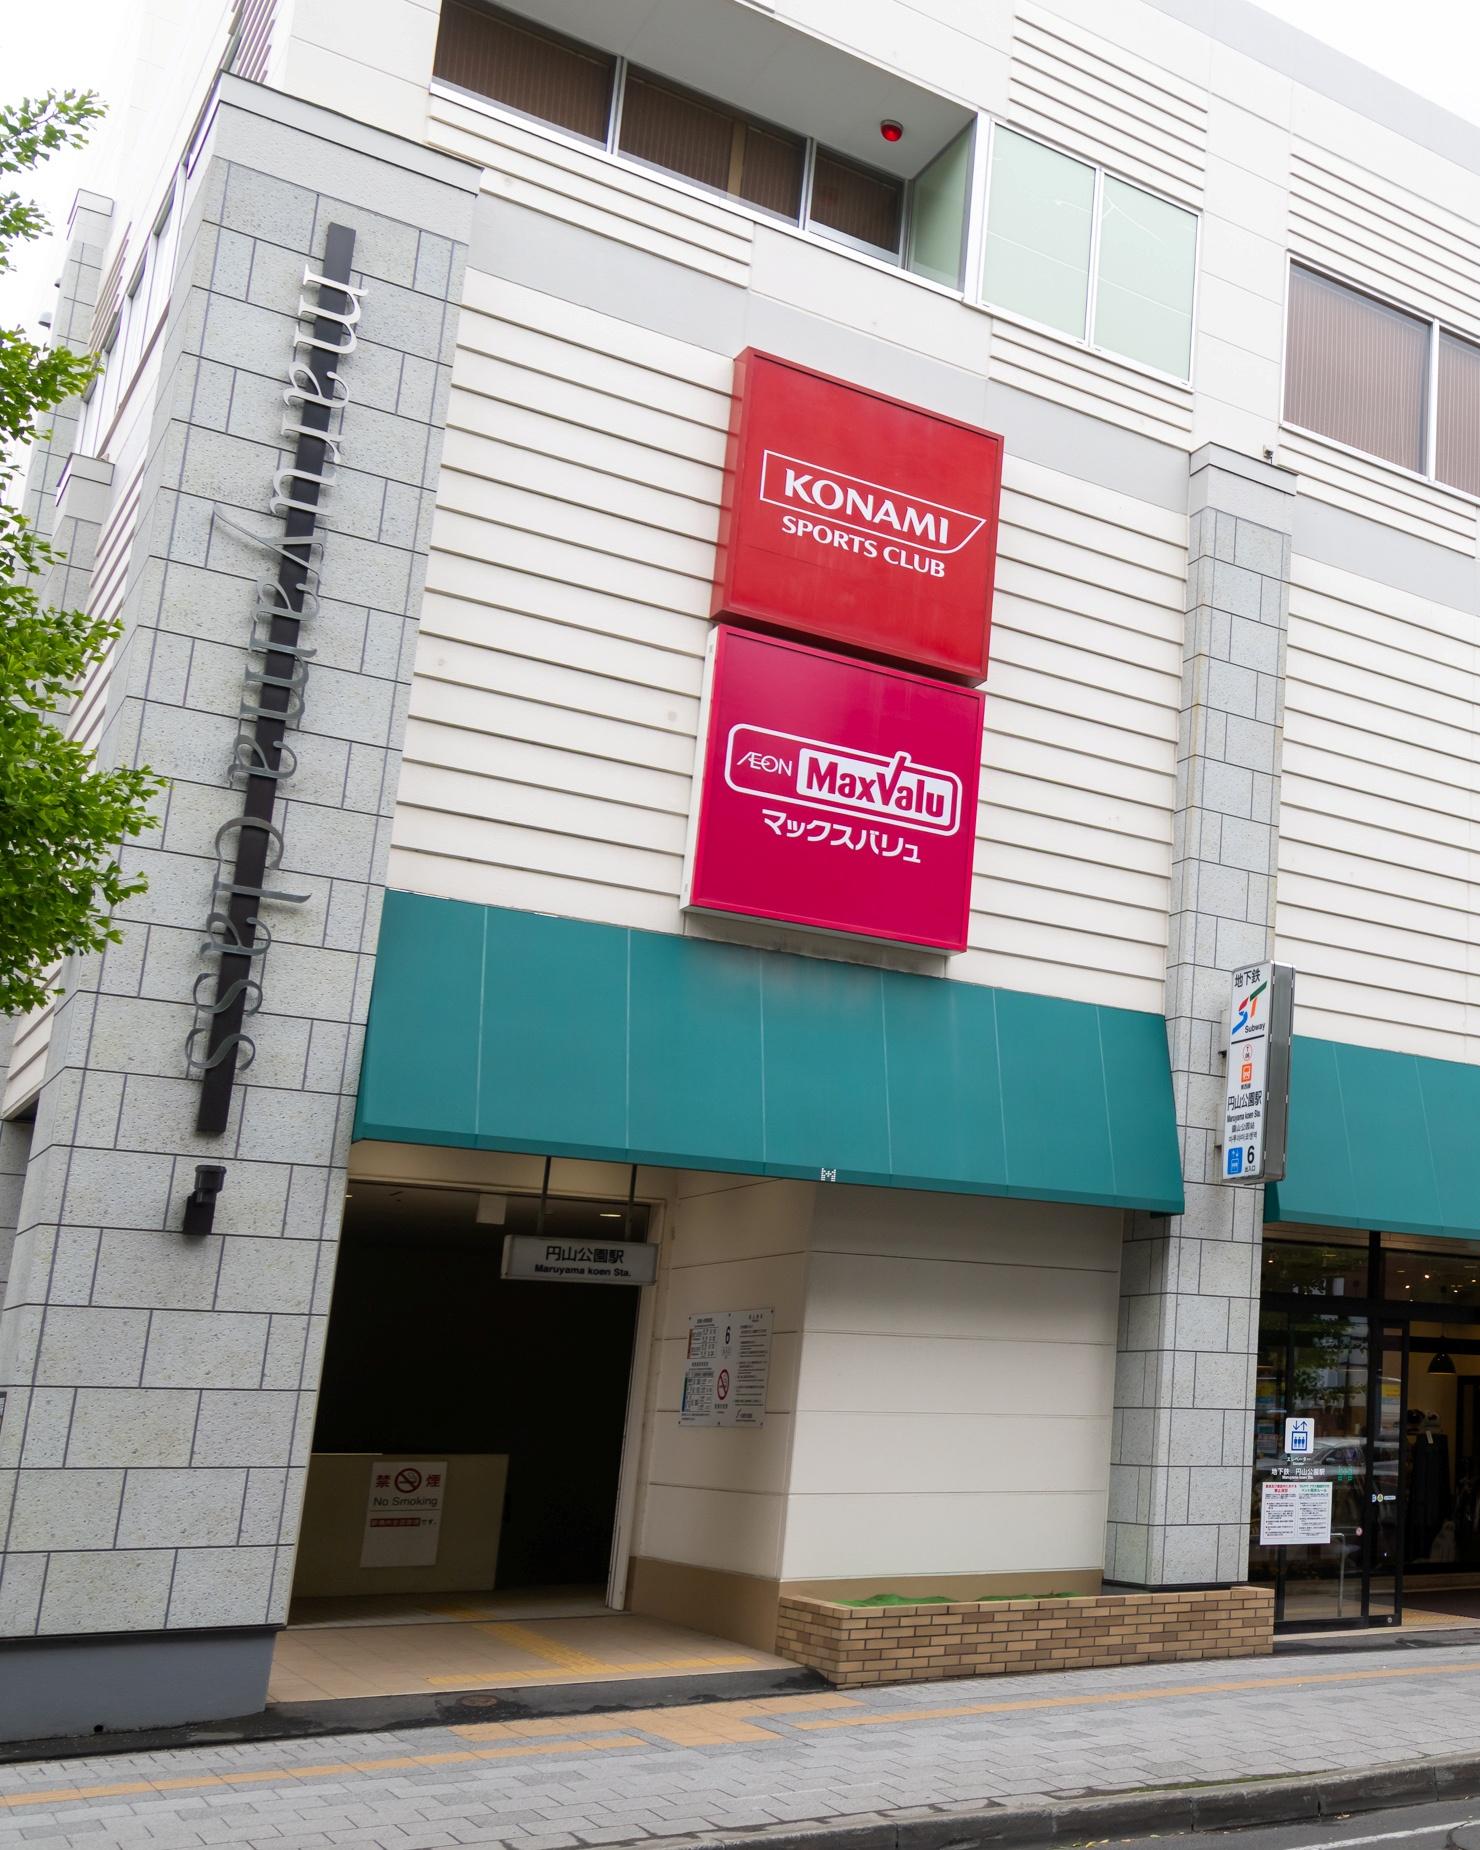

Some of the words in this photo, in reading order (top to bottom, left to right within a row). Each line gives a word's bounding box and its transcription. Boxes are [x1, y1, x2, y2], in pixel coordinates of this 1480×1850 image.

[784, 468, 949, 544] KONAMI
[781, 515, 878, 558] SPORTS
[882, 546, 945, 578] CLUB
[806, 755, 945, 818] MaxValu
[761, 808, 921, 863] マックスバリュ
[1234, 967, 1261, 988] 地下鉄
[1244, 1023, 1266, 1035] Subway
[1227, 1090, 1263, 1111] 円山公園駅
[1247, 1145, 1255, 1164] 6
[545, 1245, 624, 1264] 円山公園駅
[534, 1263, 585, 1276] Maruyama
[587, 1265, 611, 1276] koen
[614, 1268, 632, 1277] Sta.
[724, 1326, 731, 1345] 6
[375, 1474, 392, 1489] 禁
[425, 1474, 441, 1488] 煙
[373, 1497, 389, 1507] No
[392, 1496, 438, 1508] Smoking
